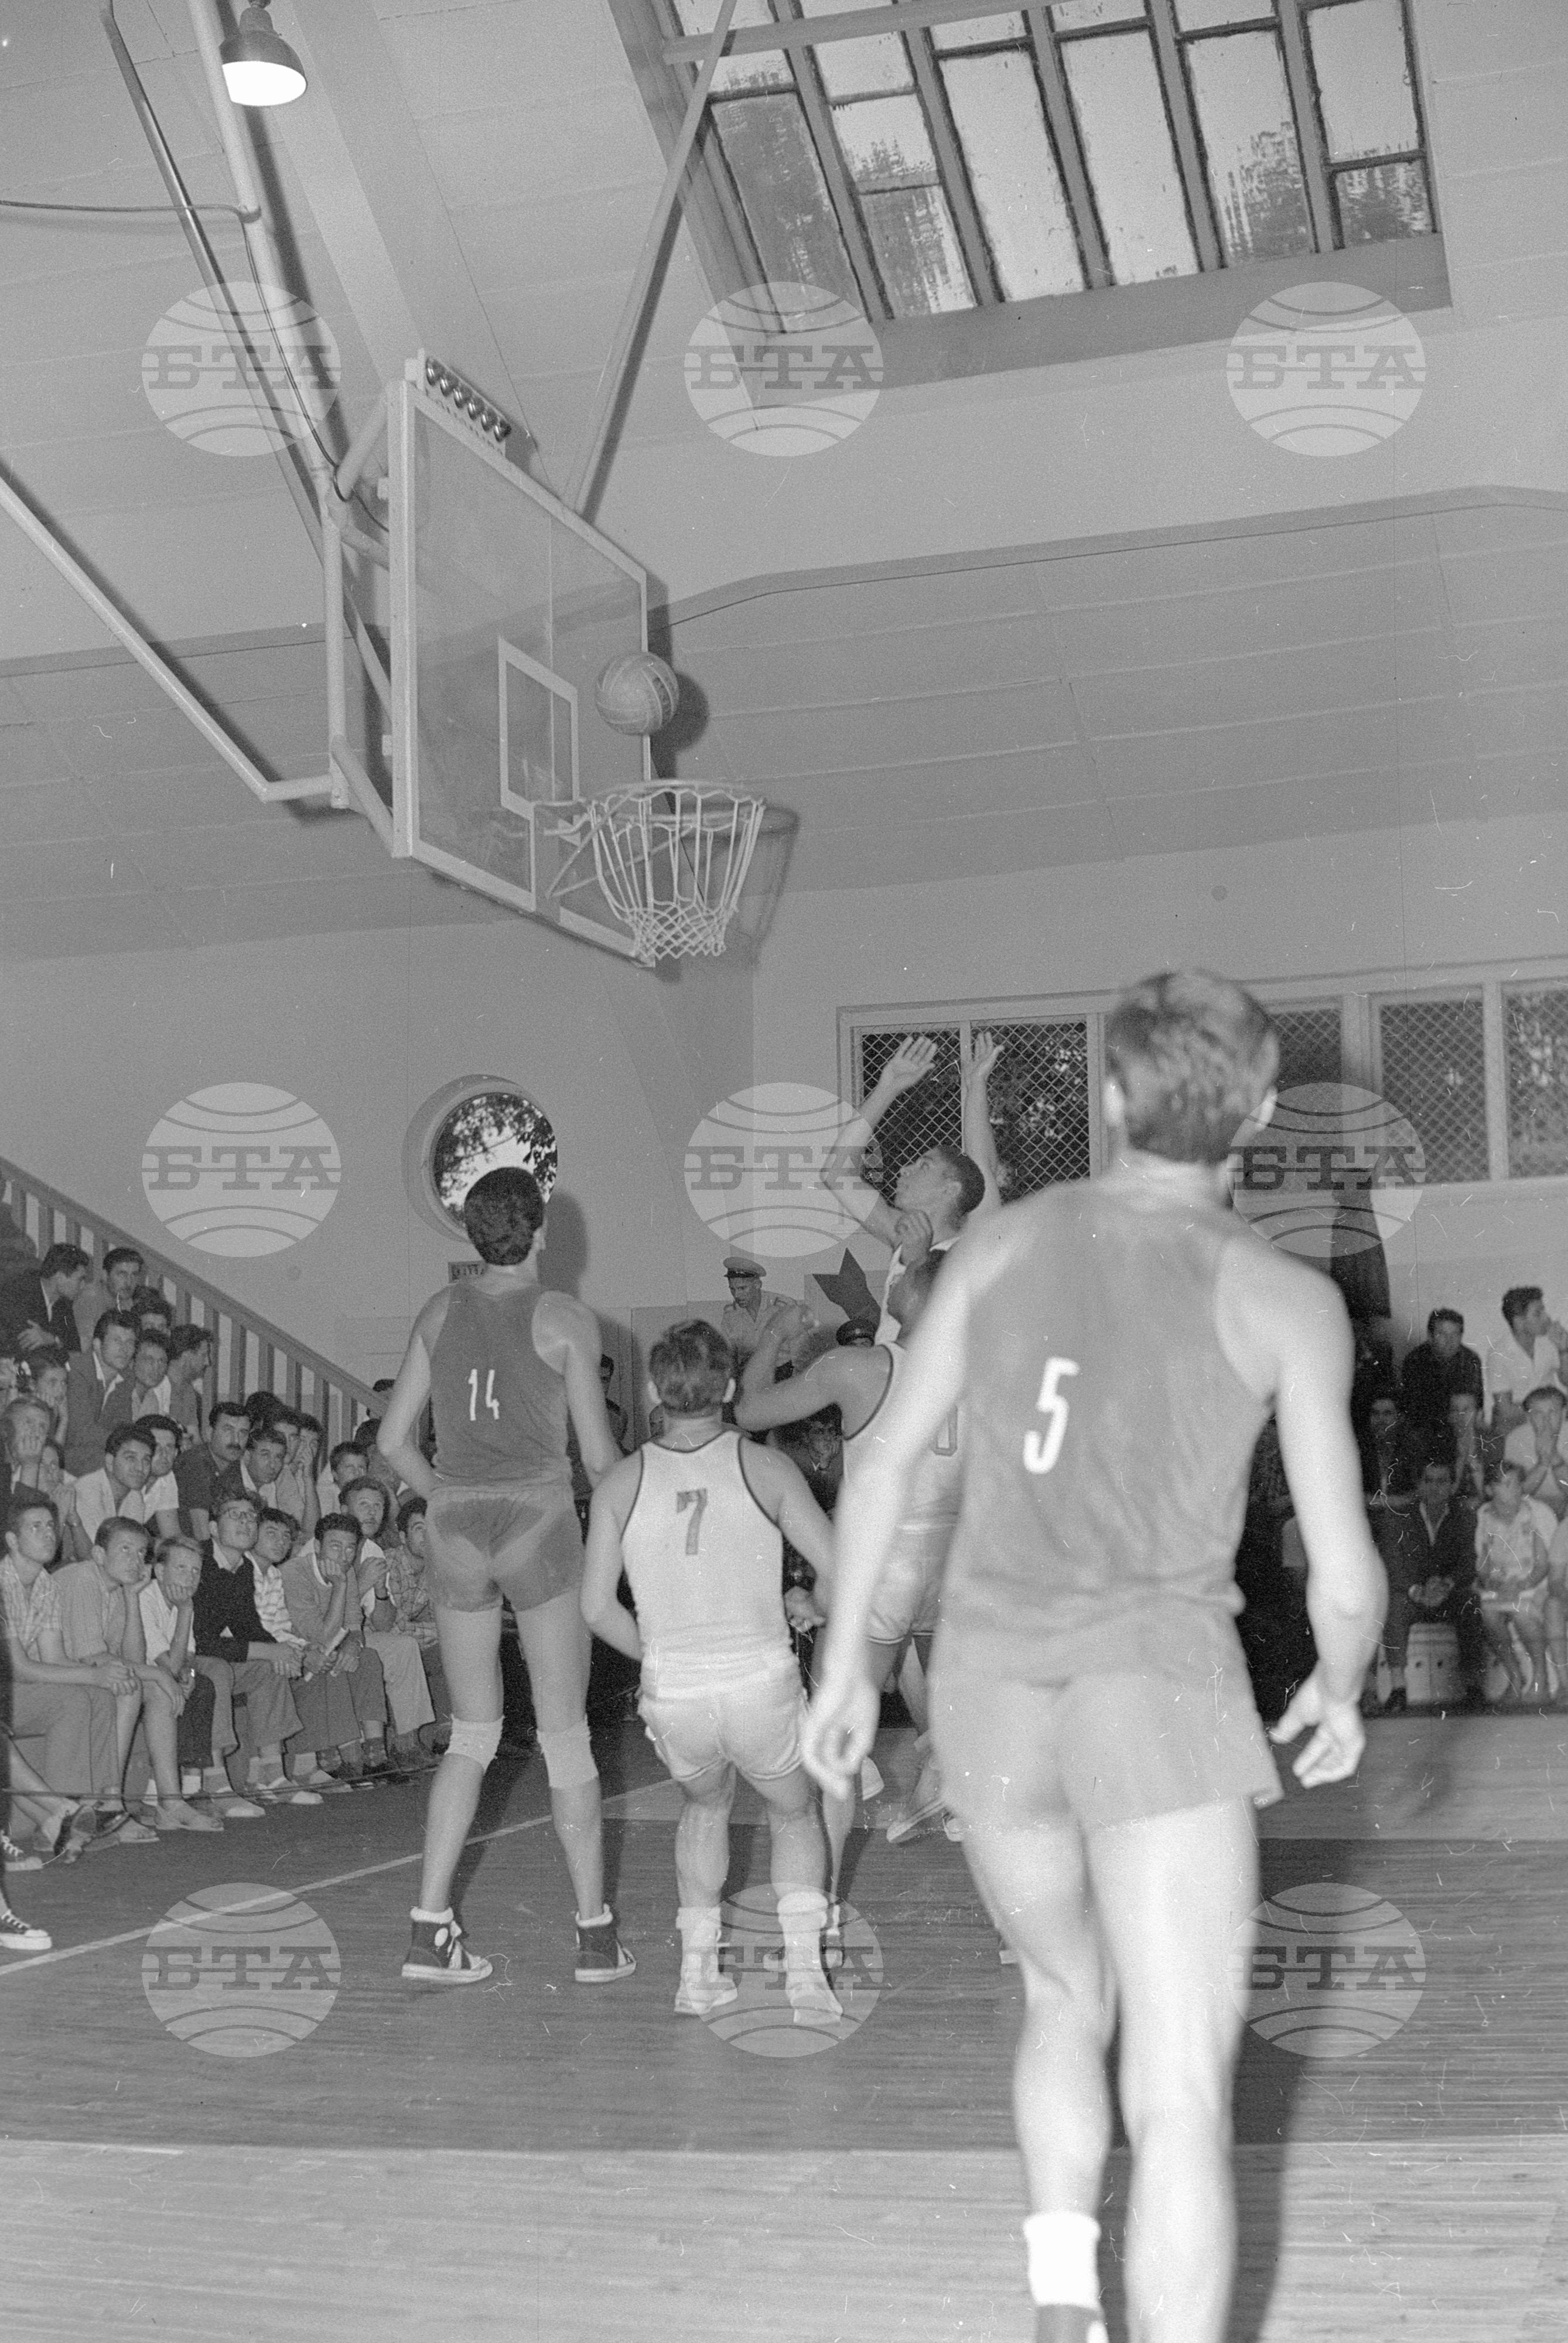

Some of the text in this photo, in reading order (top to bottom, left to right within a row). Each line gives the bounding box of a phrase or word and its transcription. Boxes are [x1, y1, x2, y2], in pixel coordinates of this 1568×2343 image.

[468, 1368, 499, 1420] 14
[1024, 1357, 1079, 1474] 5
[677, 1488, 708, 1555] 7
